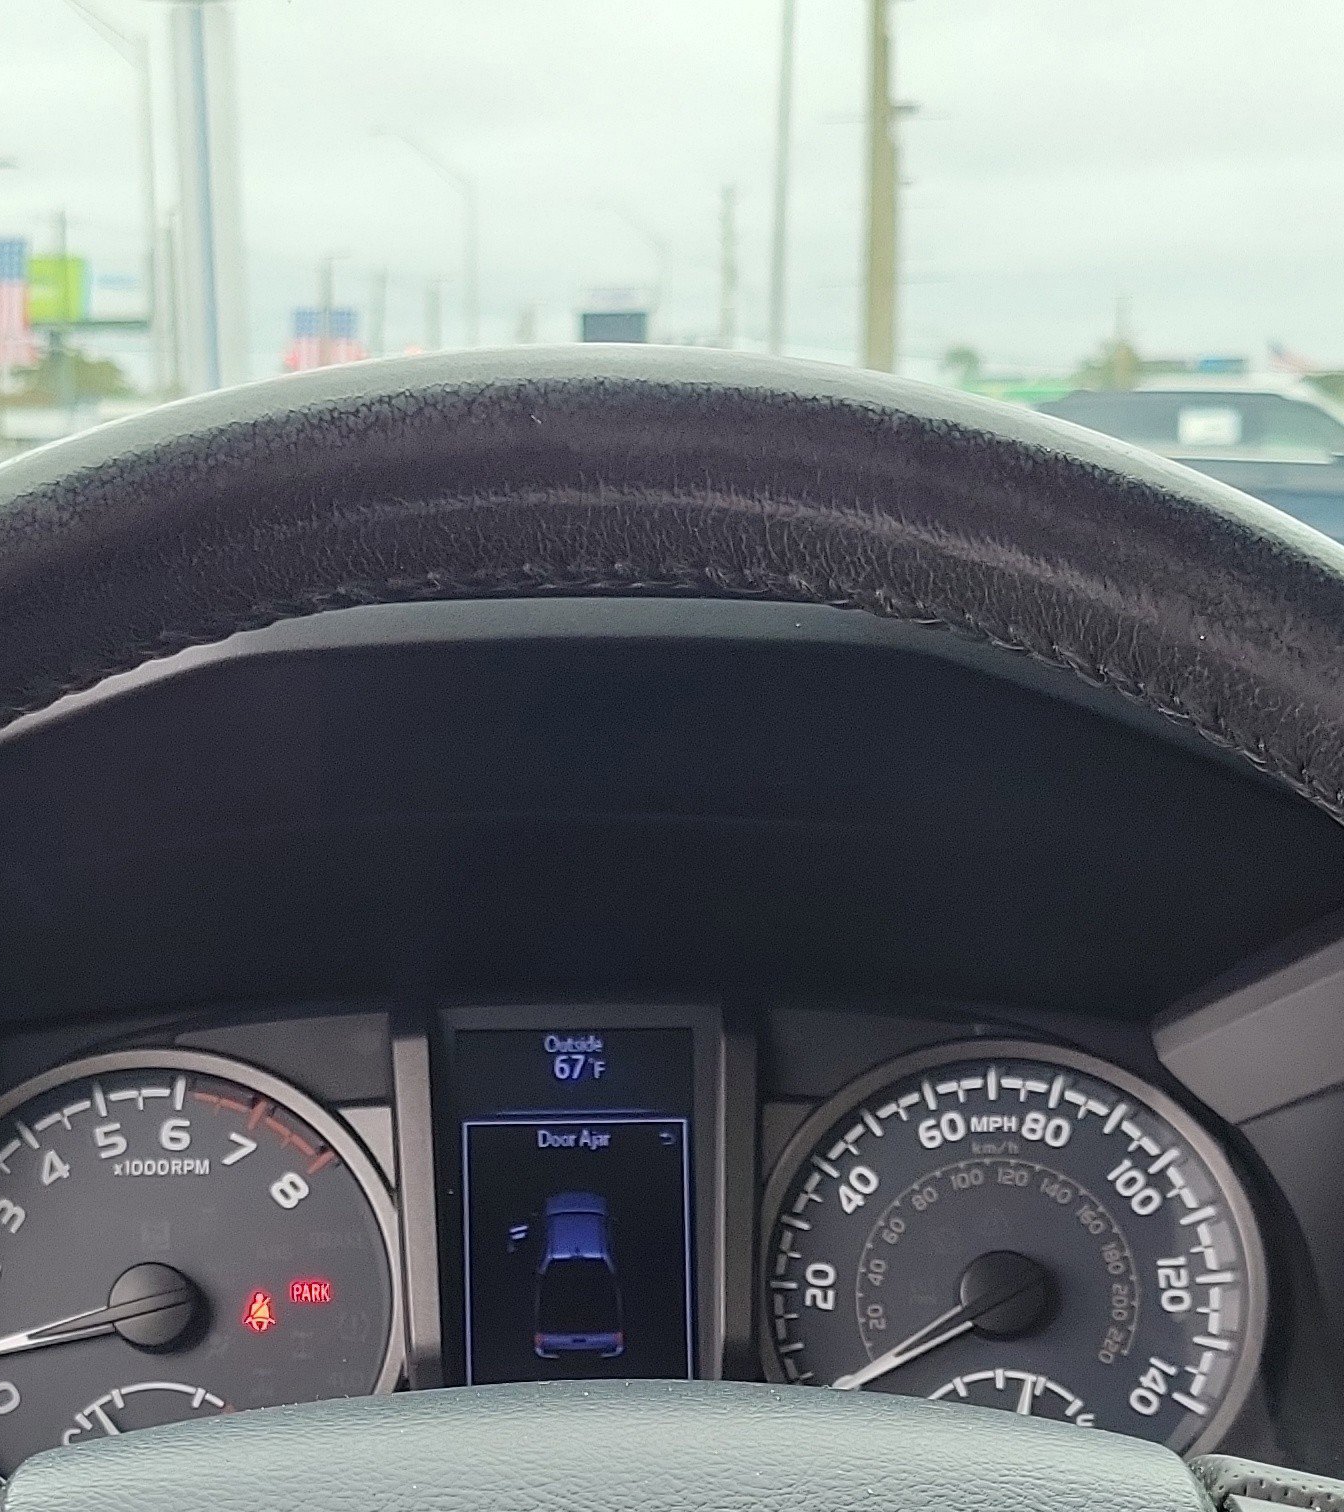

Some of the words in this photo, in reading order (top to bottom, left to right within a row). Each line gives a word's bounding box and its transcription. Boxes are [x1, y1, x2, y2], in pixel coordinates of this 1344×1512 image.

[544, 1035, 603, 1054] Outside
[93, 1122, 128, 1159] 5
[160, 1119, 191, 1151] 6
[537, 1130, 576, 1148] Door
[578, 1129, 612, 1150] Ajar
[917, 1112, 967, 1149] 60
[970, 1116, 1018, 1133] MPH
[1020, 1111, 1072, 1148] 80
[222, 1133, 257, 1167] 7
[971, 1140, 1020, 1155] km/h
[41, 1149, 70, 1186] 4
[950, 1168, 984, 1190] 100
[997, 1166, 1029, 1187] 120
[270, 1171, 310, 1210] 8
[838, 1165, 880, 1215] 40
[911, 1186, 939, 1211] 80
[1106, 1158, 1162, 1216] 100
[881, 1217, 906, 1246] 60
[805, 1263, 837, 1312] 20
[867, 1258, 887, 1287] 40
[1156, 1257, 1192, 1313] 120
[290, 1281, 331, 1303] PARK
[1111, 1283, 1131, 1321] 200
[867, 1304, 887, 1331] 20
[1129, 1357, 1177, 1416] 140
